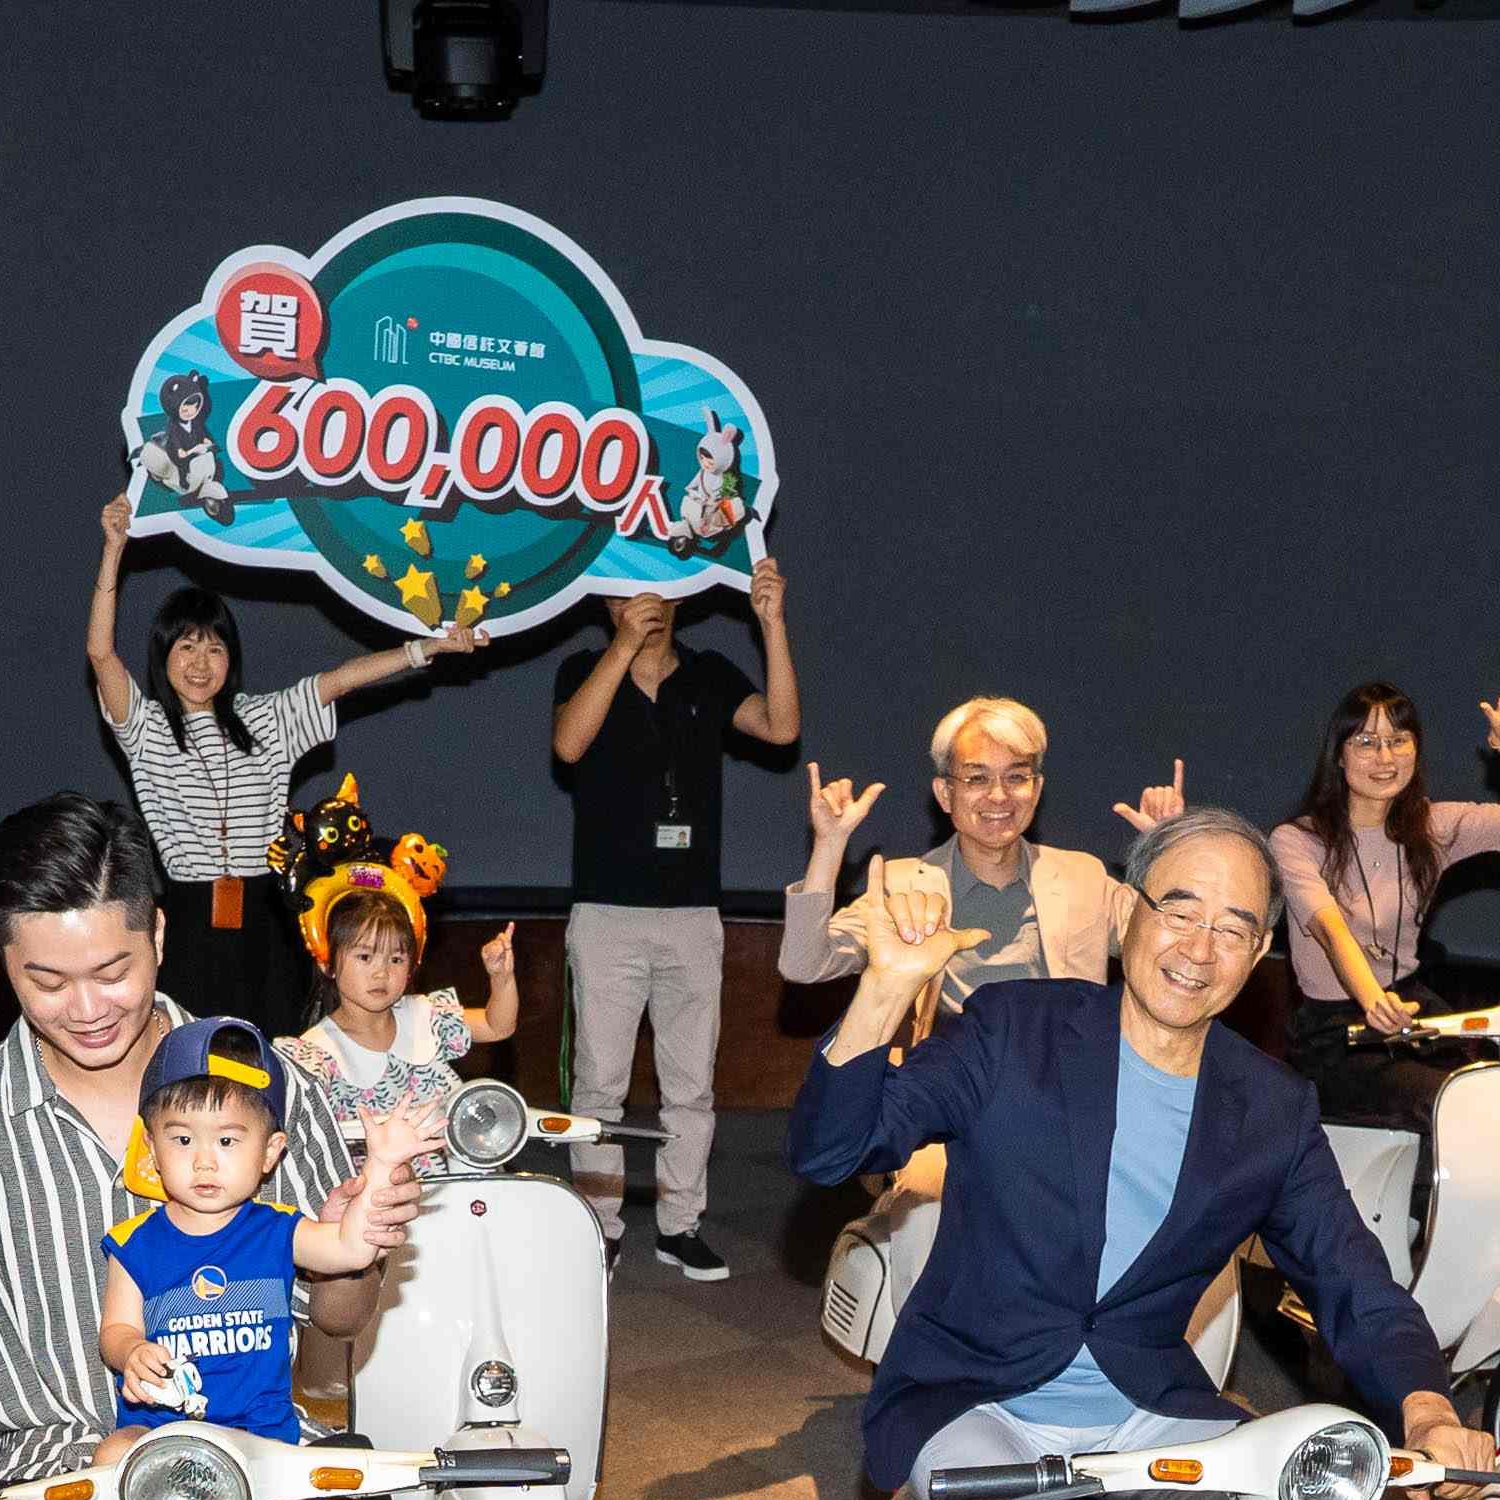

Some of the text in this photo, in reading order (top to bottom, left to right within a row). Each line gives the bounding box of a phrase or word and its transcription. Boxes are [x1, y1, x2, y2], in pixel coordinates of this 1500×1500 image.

[238, 289, 299, 358] 賀
[429, 352, 516, 372] CTBC MUSEUM
[168, 1310, 264, 1332] GOLDEN STATE
[157, 1325, 273, 1359] WARRIORS
